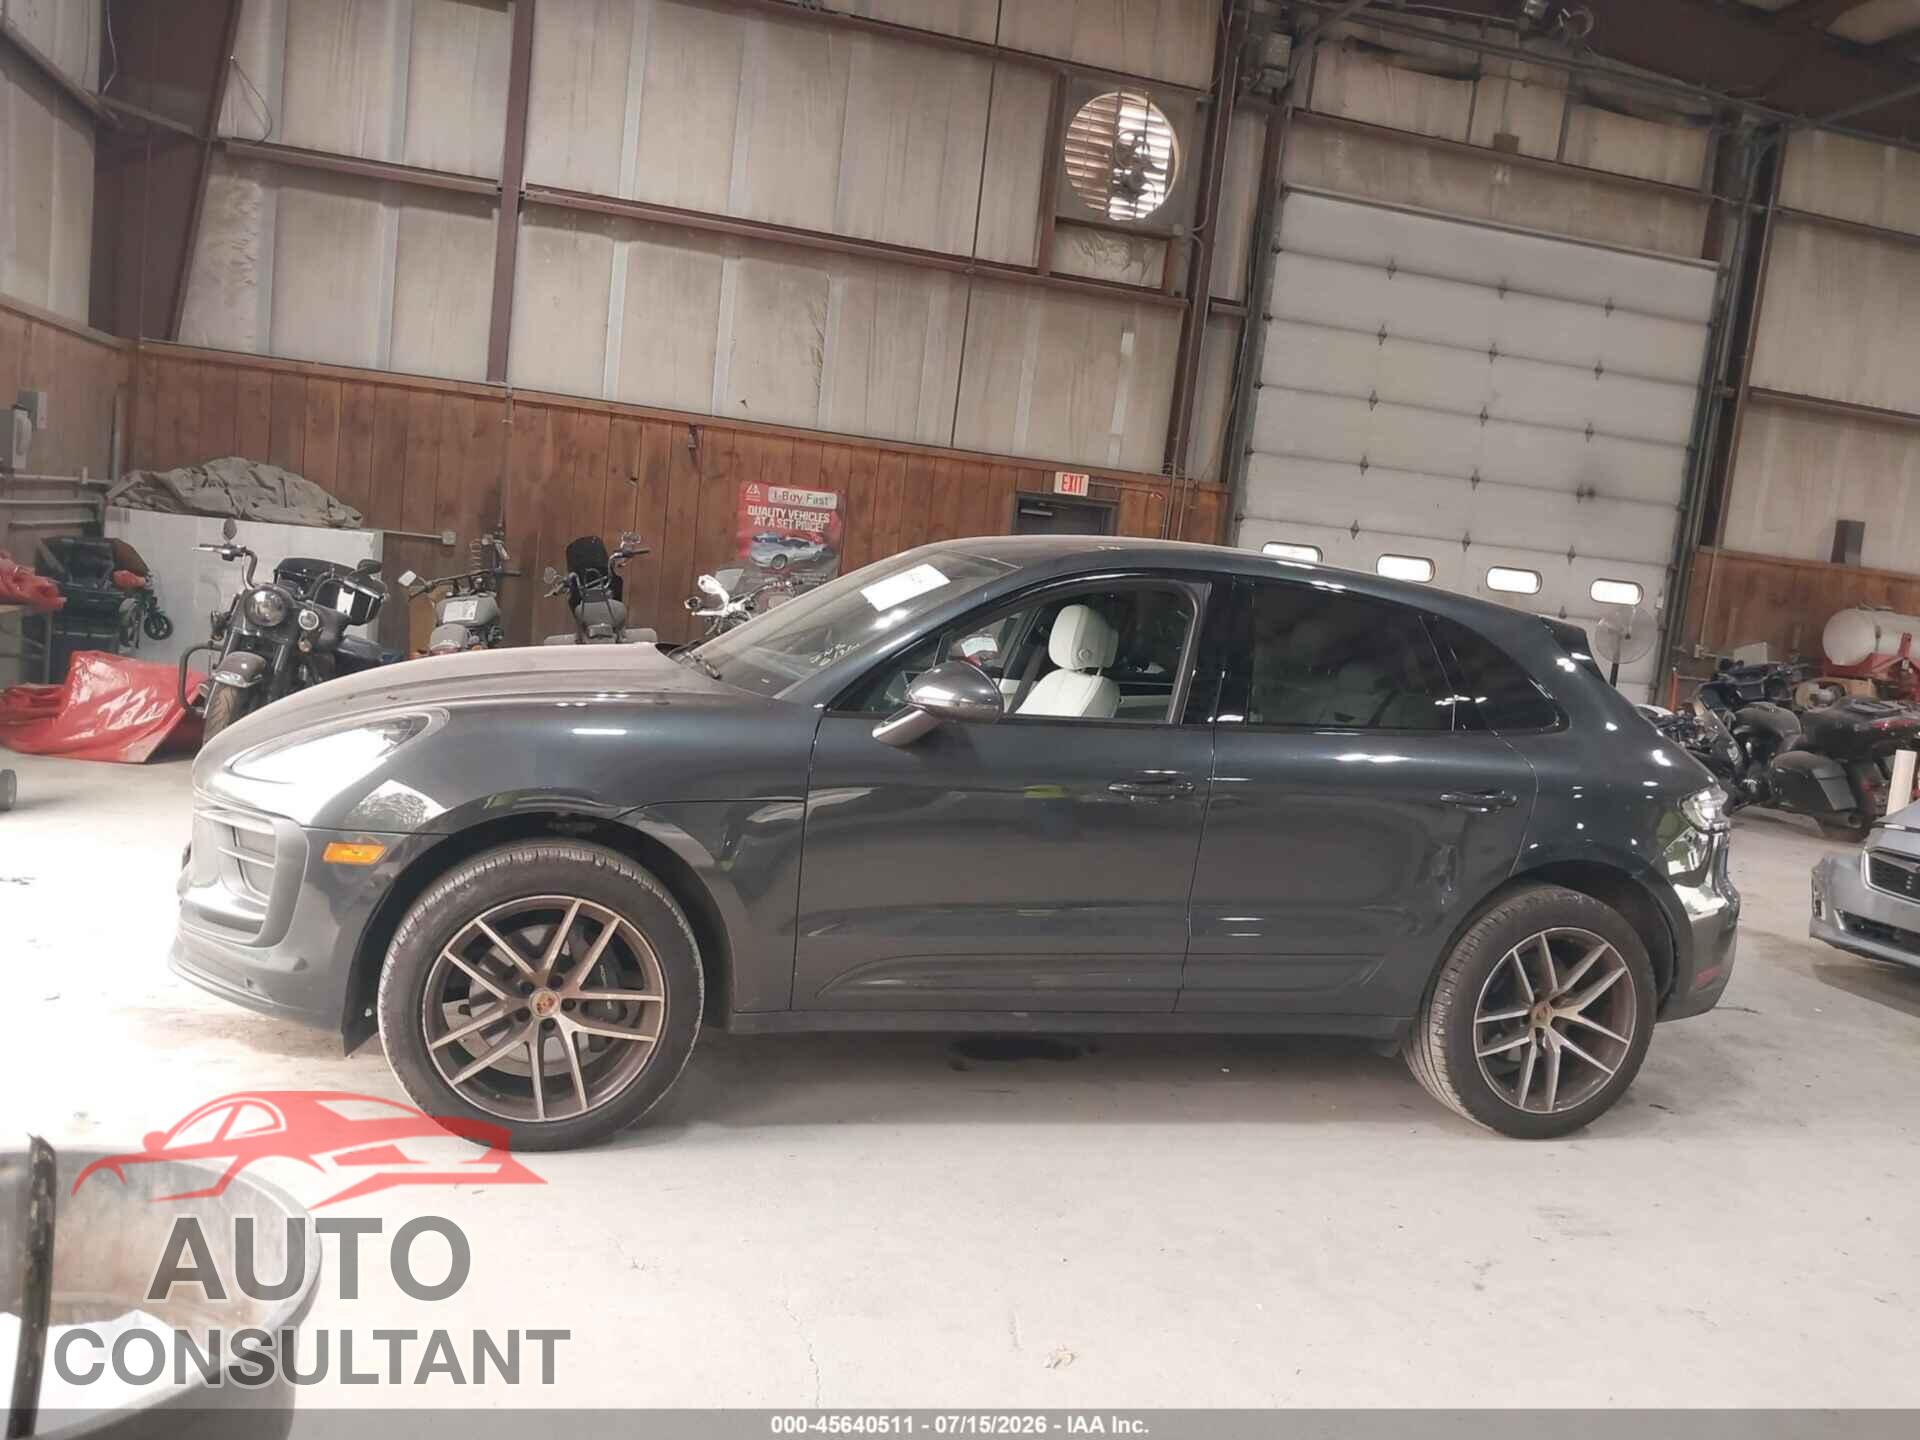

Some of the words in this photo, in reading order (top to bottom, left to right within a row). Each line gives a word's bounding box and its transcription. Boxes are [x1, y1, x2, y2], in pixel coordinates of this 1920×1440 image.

[1062, 474, 1084, 492] EXIT
[747, 505, 786, 518] QUALITY
[788, 509, 830, 523] VEHICLES
[753, 515, 767, 527] AT
[767, 517, 775, 528] A
[776, 518, 794, 530] SET
[795, 519, 825, 533] PRICE!
